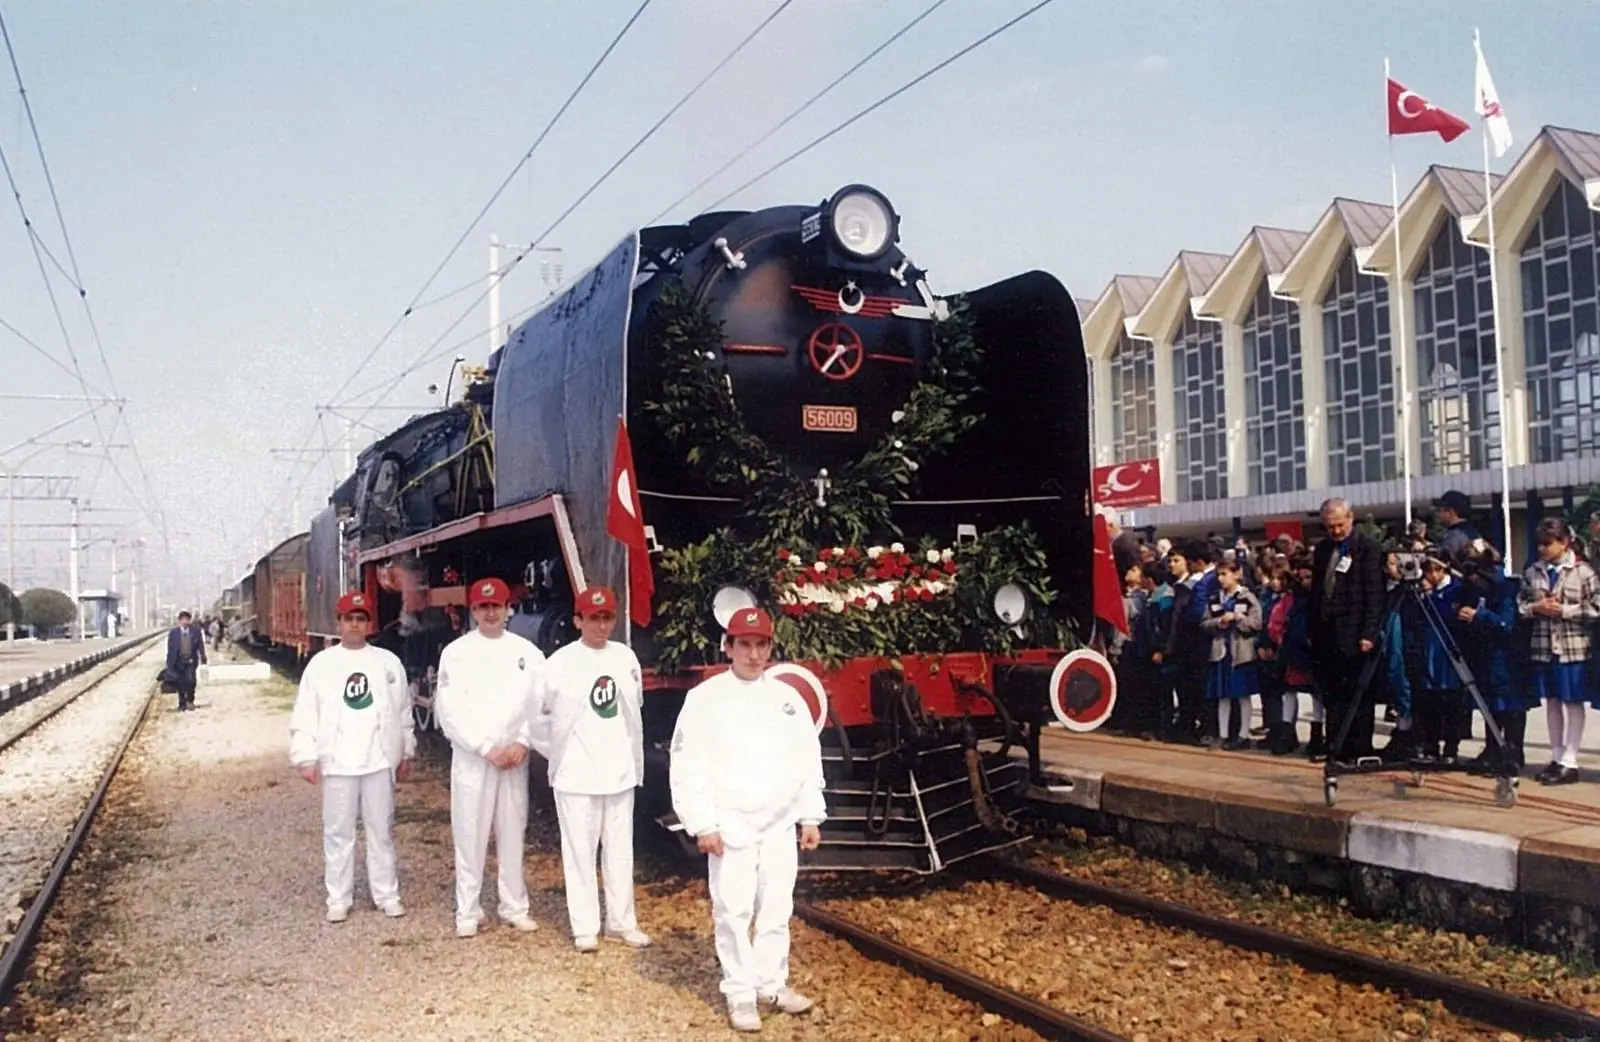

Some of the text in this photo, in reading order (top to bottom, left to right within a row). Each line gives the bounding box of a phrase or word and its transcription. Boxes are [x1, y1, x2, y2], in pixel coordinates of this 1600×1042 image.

[807, 410, 852, 428] 56009
[346, 676, 366, 698] Cif
[593, 679, 613, 705] Cif
